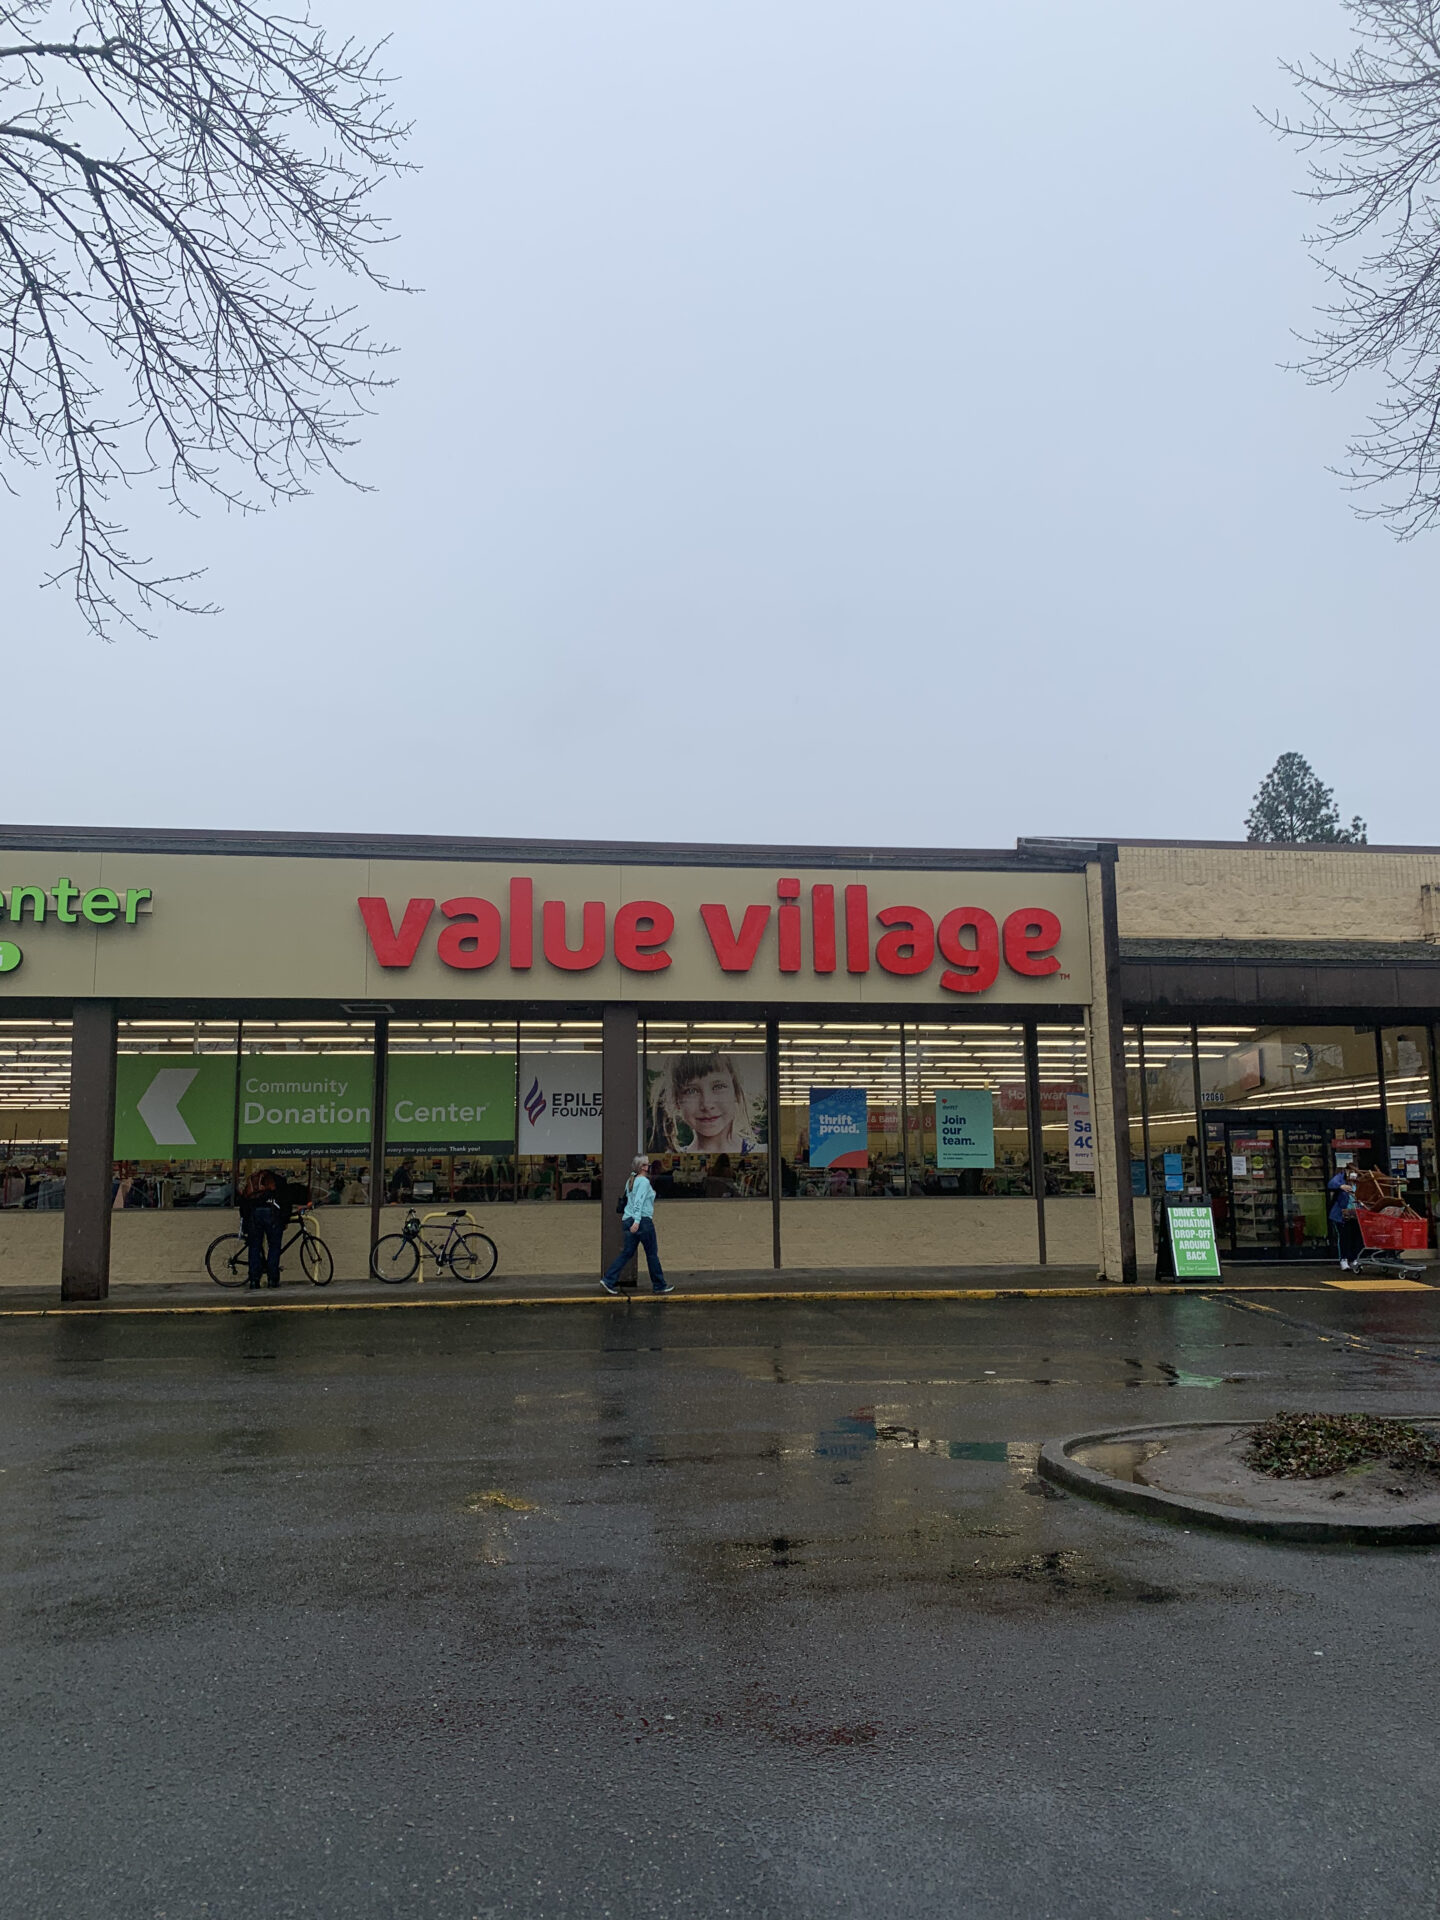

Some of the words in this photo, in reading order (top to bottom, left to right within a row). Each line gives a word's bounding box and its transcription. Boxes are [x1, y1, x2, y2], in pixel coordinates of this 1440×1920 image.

[0, 877, 152, 924] nter
[357, 877, 675, 972] value
[700, 877, 1062, 994] village
[245, 1078, 348, 1097] Community
[244, 1101, 371, 1125] Donation
[394, 1100, 487, 1123] Center
[819, 1114, 853, 1126] thrift
[924, 1116, 933, 1128] 8
[942, 1115, 967, 1126] Join
[820, 1124, 860, 1136] proud.
[942, 1127, 963, 1136] our
[943, 1136, 976, 1146] team.
[467, 1145, 481, 1153] you!
[1173, 1208, 1196, 1217] DRIVE
[1196, 1208, 1207, 1217] UP
[1173, 1219, 1210, 1228] DONATION
[1174, 1229, 1211, 1239] DROP-OFF
[1179, 1240, 1210, 1250] AROUND
[1186, 1251, 1207, 1261] BACK
